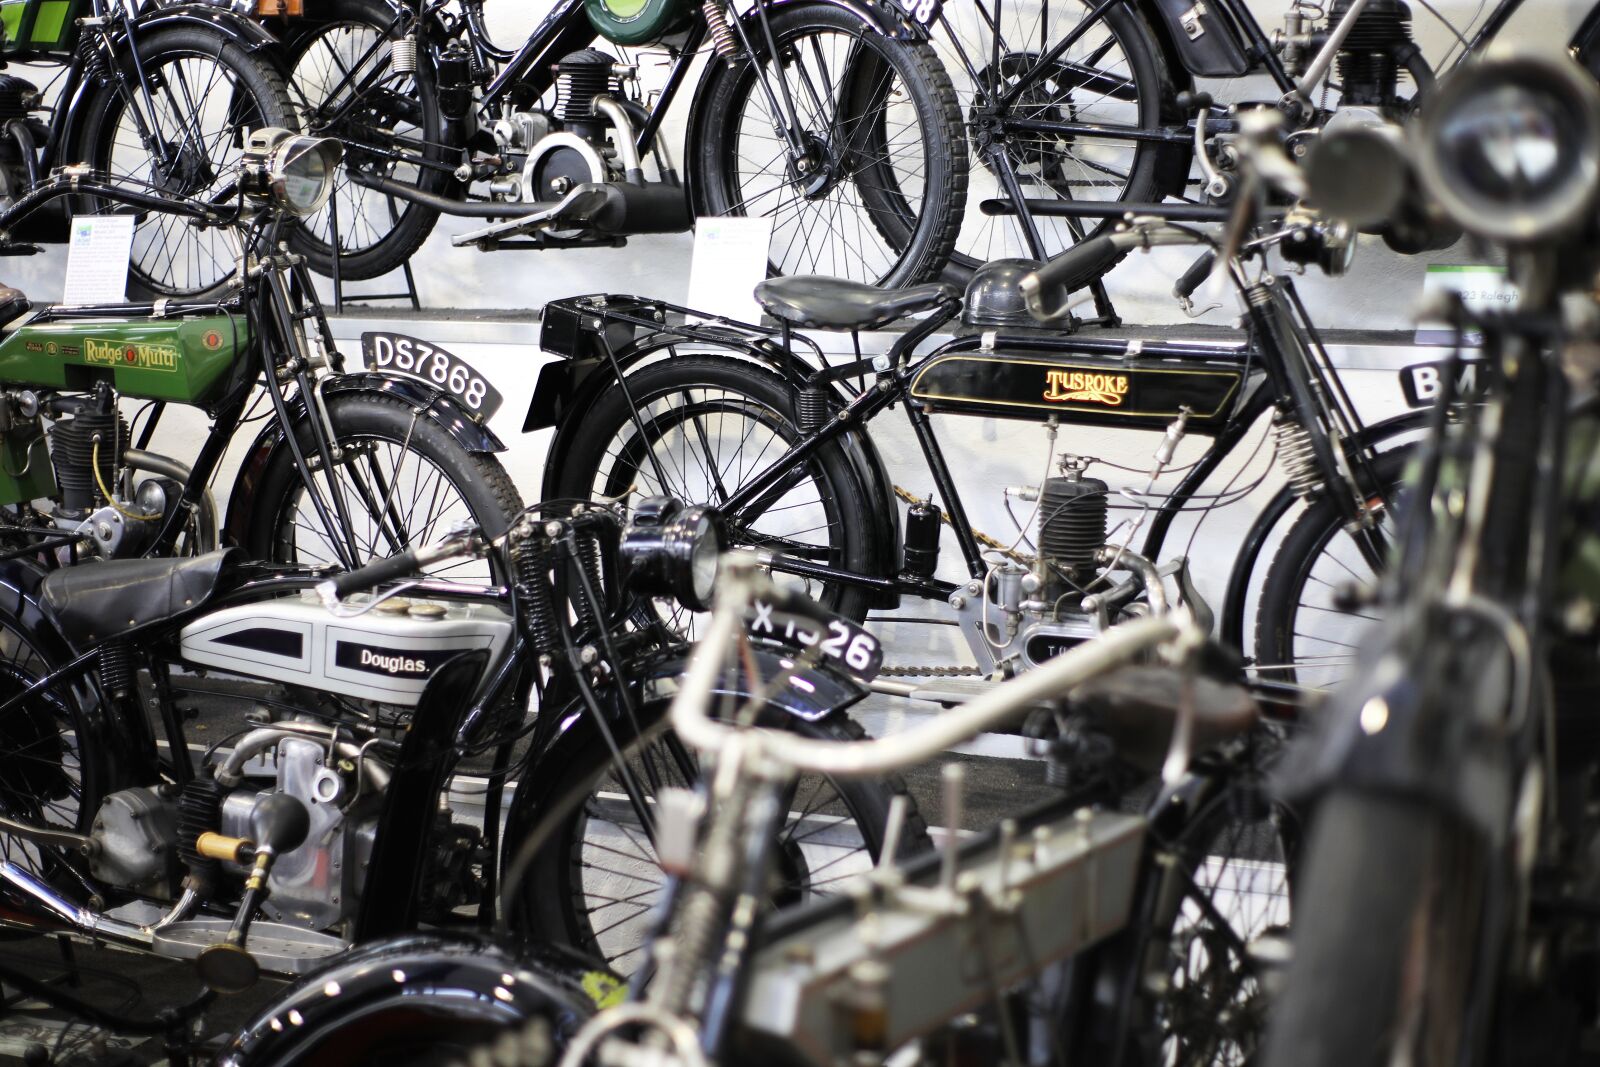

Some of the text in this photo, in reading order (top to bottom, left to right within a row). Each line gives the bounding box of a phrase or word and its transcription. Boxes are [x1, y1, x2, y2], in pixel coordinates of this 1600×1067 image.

[86, 340, 122, 365] Rudge
[138, 345, 174, 367] Multi
[375, 336, 487, 409] DS7868
[361, 649, 430, 673] Douglas.
